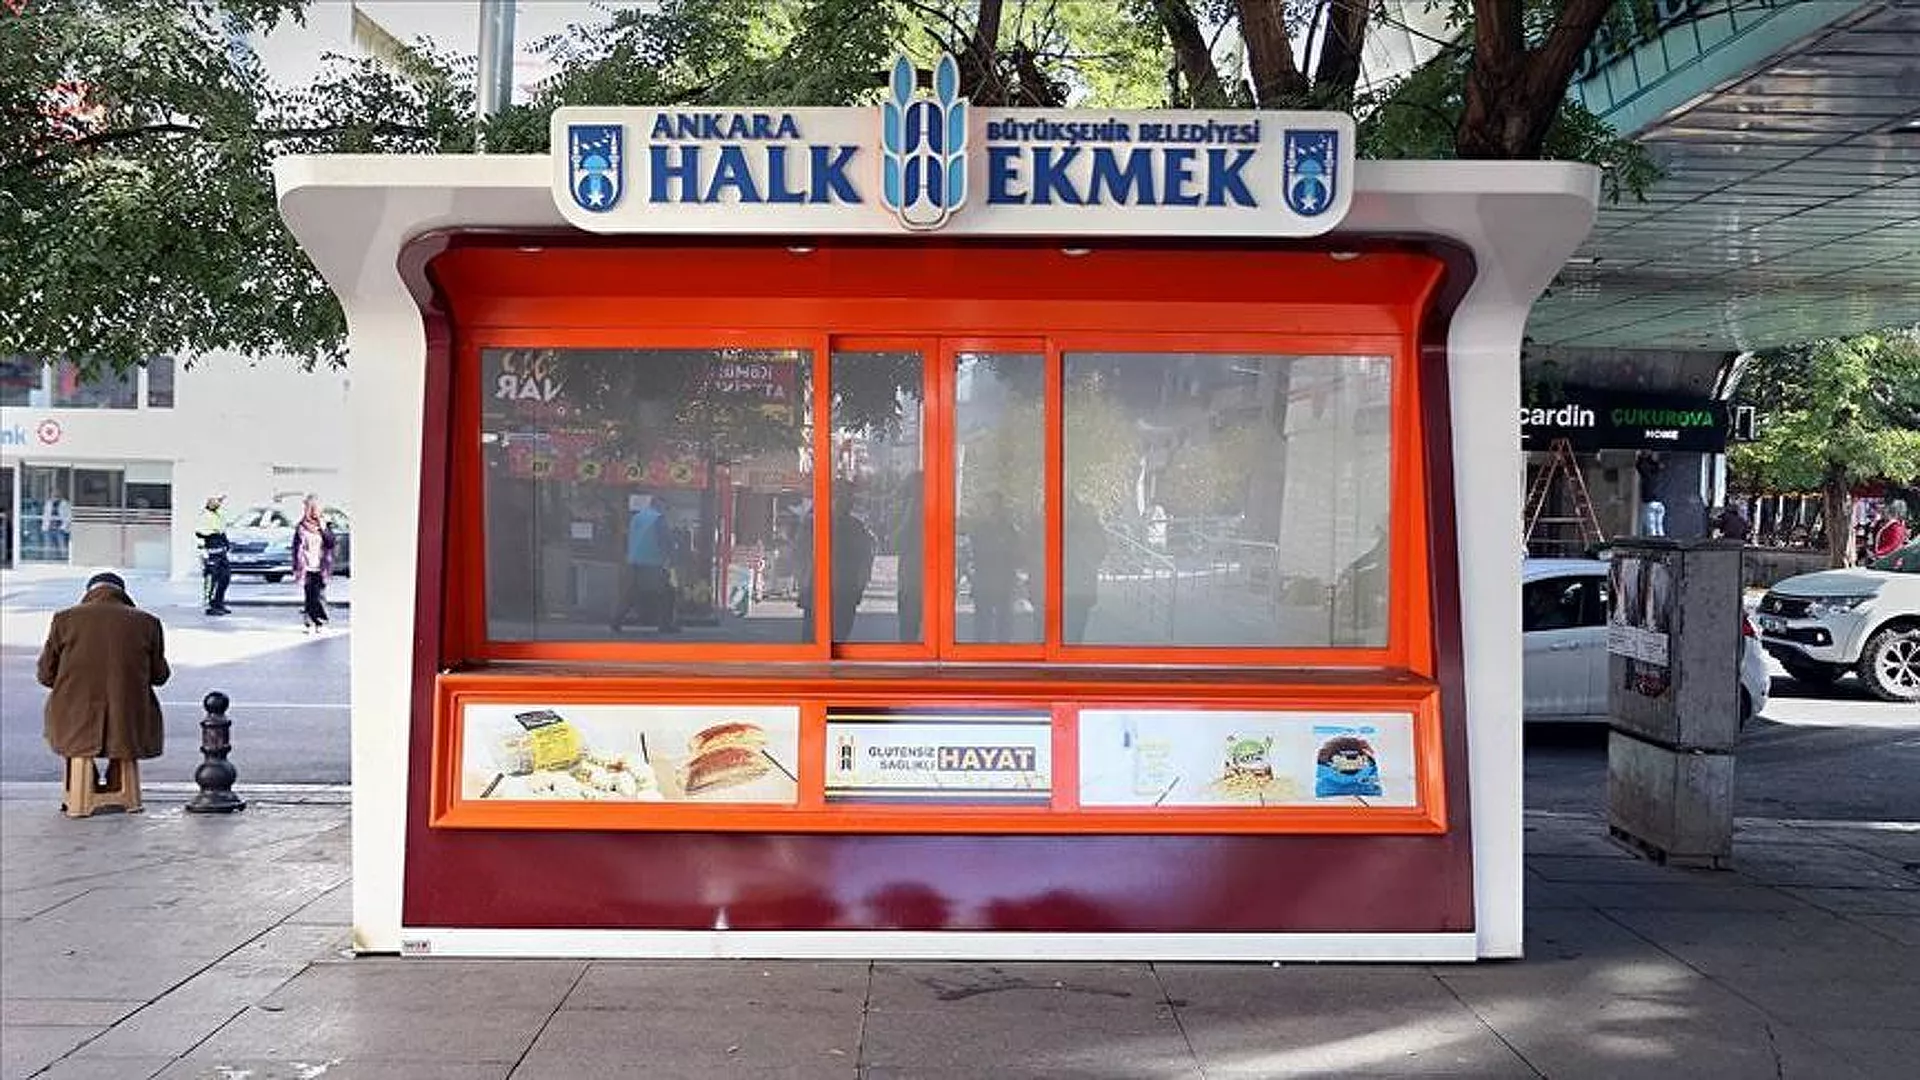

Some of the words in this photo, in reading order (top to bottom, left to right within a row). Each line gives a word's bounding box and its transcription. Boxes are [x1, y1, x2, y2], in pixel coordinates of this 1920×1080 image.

[651, 113, 800, 140] ANKARA
[987, 117, 1131, 146] BÜYÜKŞEHİR
[1139, 118, 1260, 143] BELEDİYESİ
[649, 144, 862, 204] HALK
[987, 146, 1259, 208] EKMEK
[1517, 404, 1595, 428] cardin
[1611, 408, 1714, 429] ÇUKUROVA
[940, 747, 1033, 770] HAYAT
